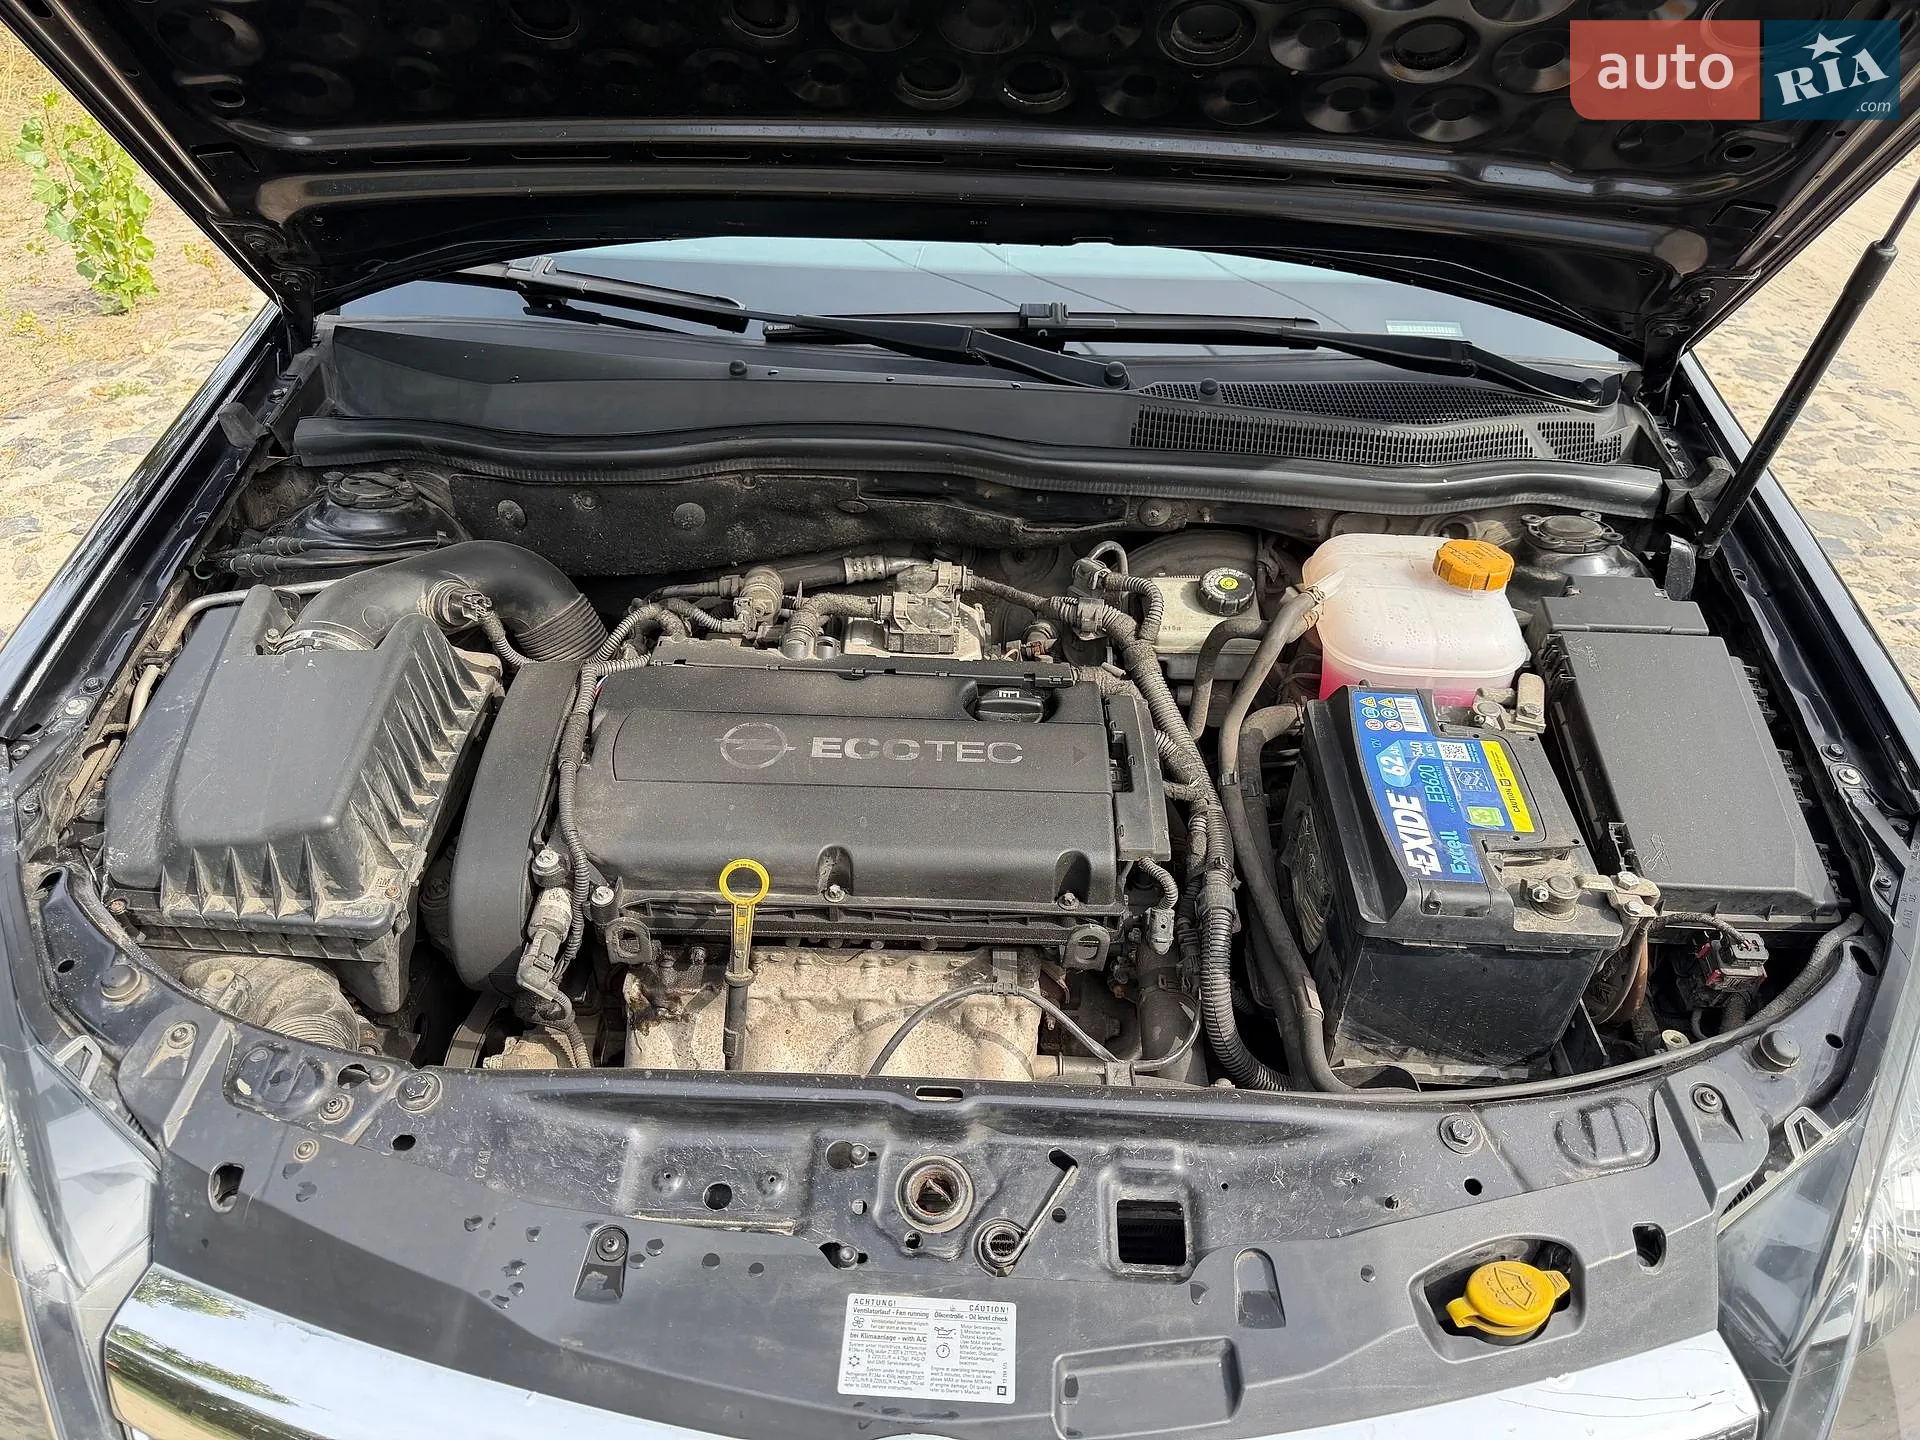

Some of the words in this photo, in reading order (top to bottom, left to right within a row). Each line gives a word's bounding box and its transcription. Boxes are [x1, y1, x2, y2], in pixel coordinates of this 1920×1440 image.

[810, 737, 1024, 764] ECOTEC
[1371, 738, 1381, 748] 12V
[1411, 742, 1424, 758] 540
[1393, 747, 1401, 756] Ah
[1383, 755, 1407, 777] 62
[1418, 765, 1445, 804] EB620
[1502, 788, 1520, 813] CAUTION
[1388, 792, 1442, 875] EXIDE
[1441, 830, 1471, 874] Excell
[854, 1298, 896, 1307] ACHTUNG!
[969, 1305, 1008, 1313] CAUTION!
[853, 1307, 891, 1315] Ventilatorlauf
[860, 1333, 896, 1341] Klimaanlage
